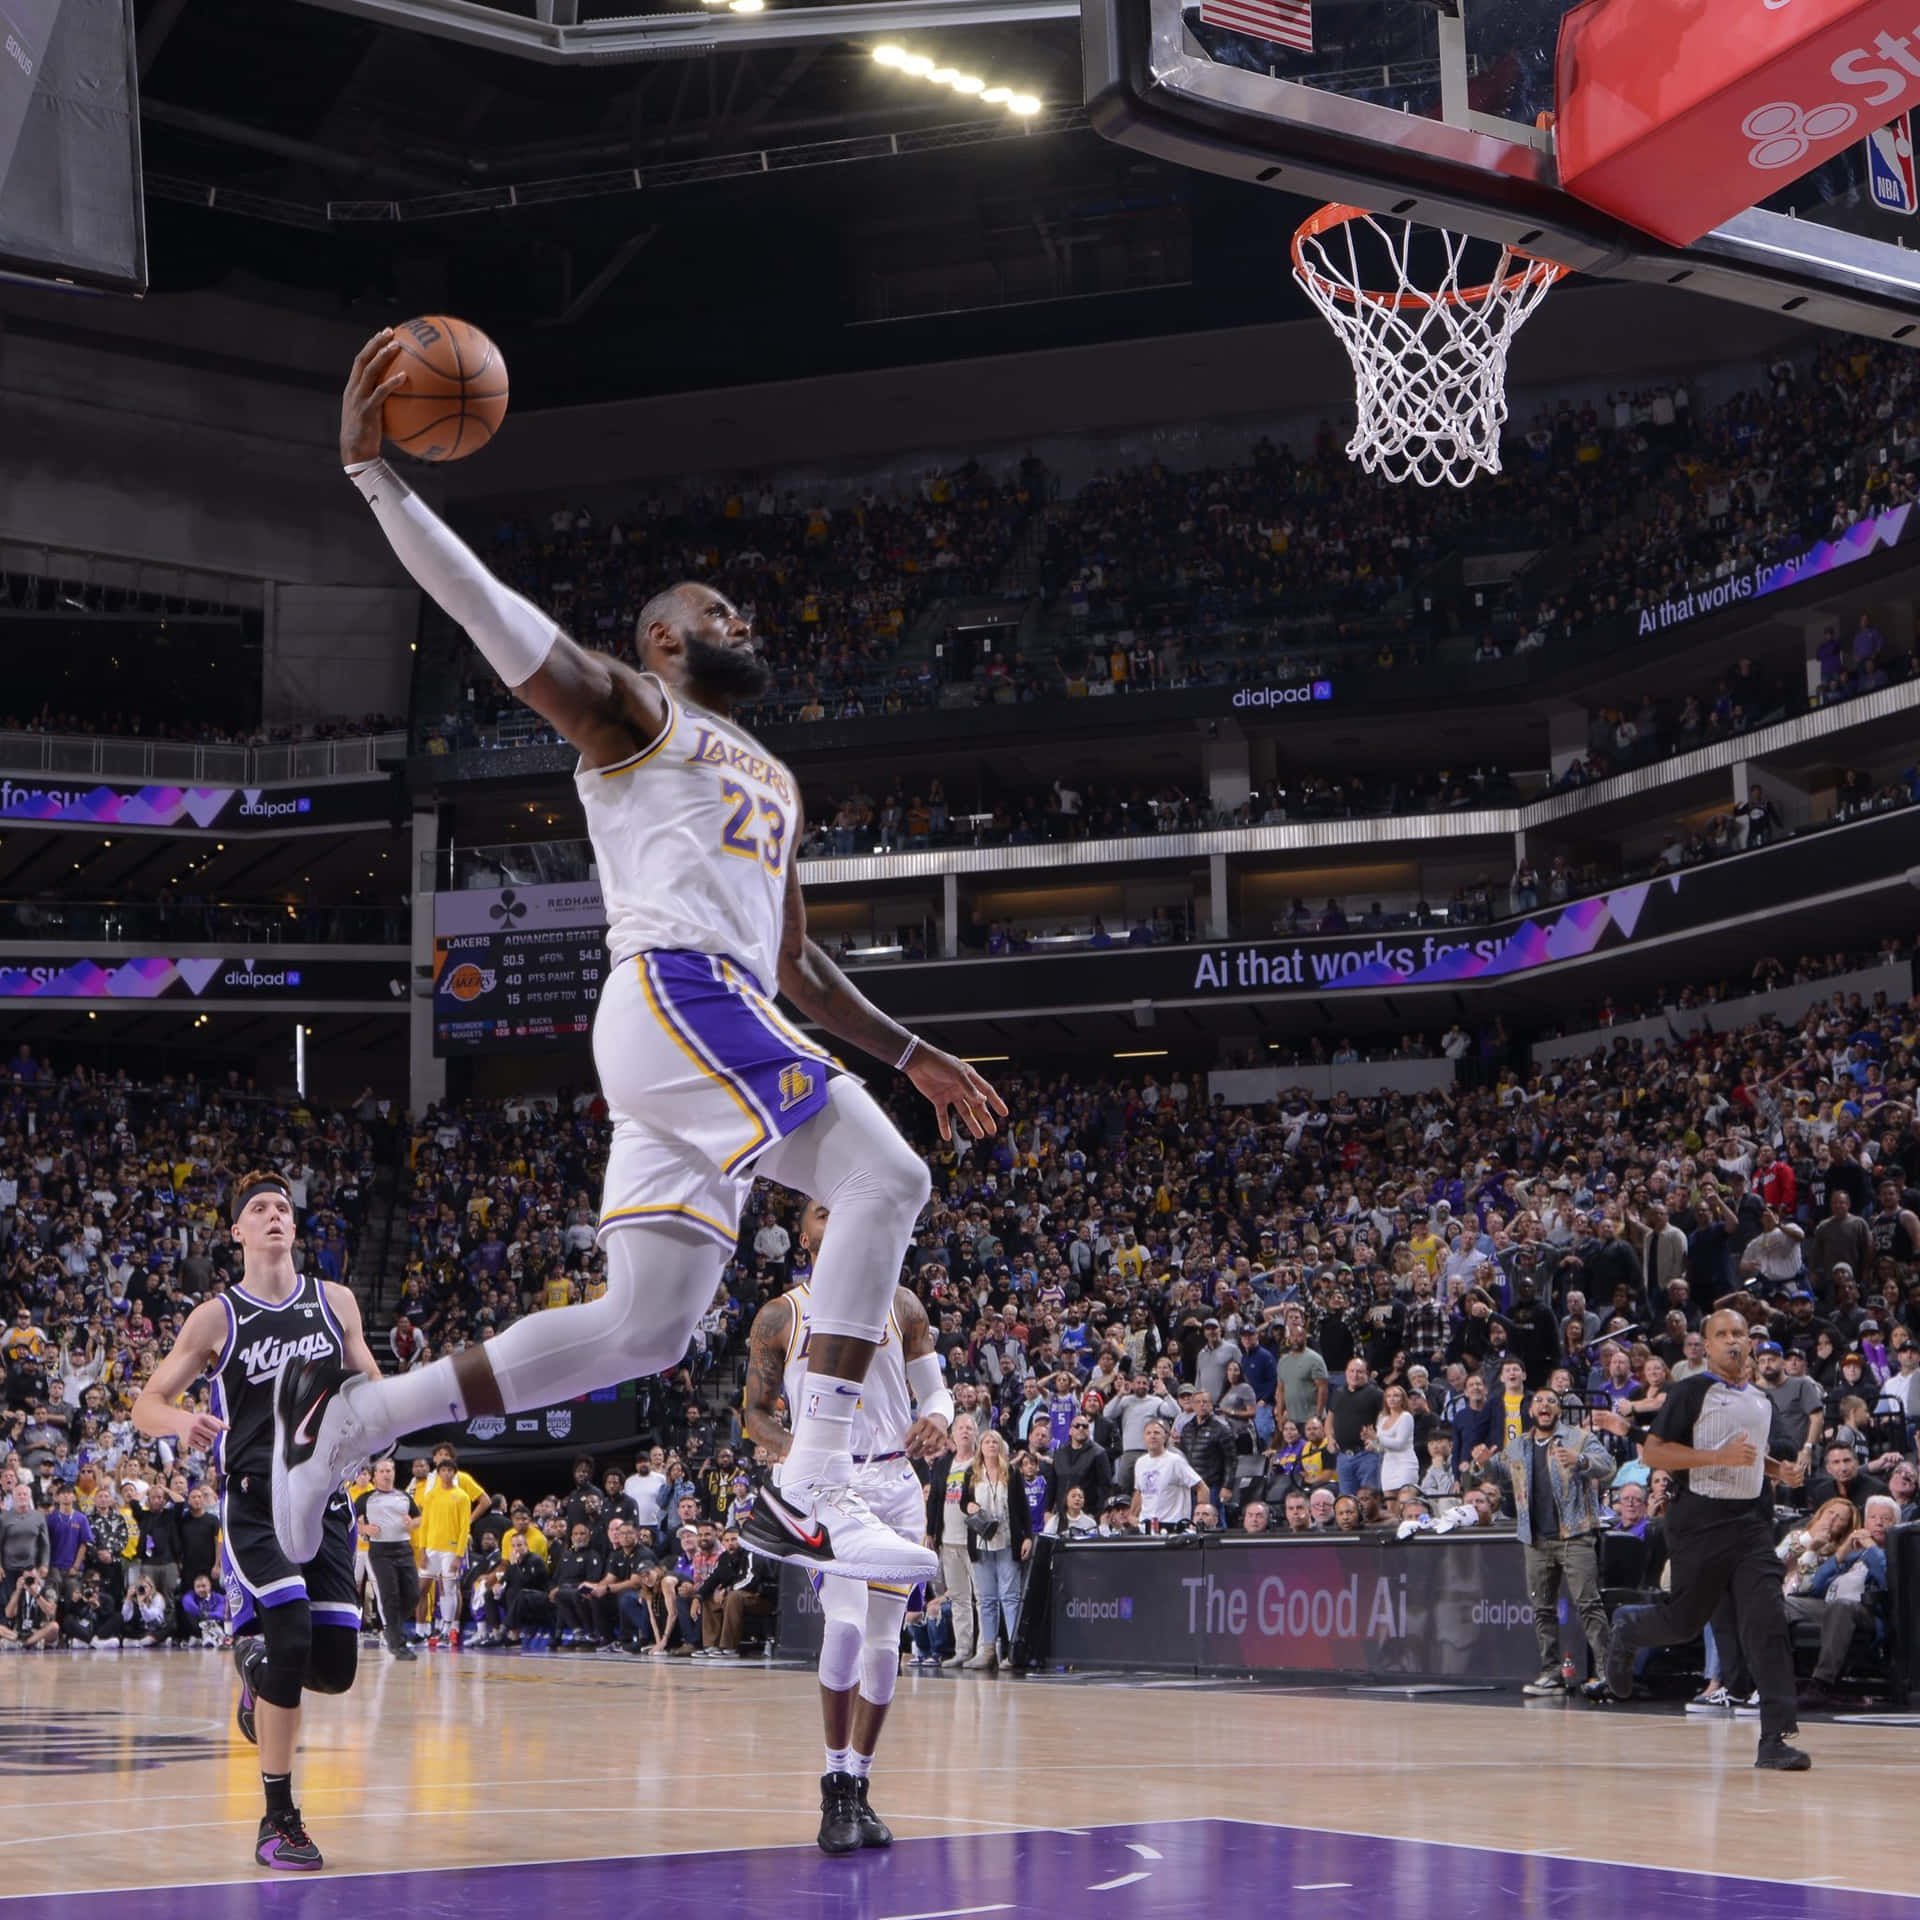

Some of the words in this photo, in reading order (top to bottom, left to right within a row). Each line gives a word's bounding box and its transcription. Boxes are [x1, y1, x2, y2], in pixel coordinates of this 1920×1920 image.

[6, 34, 33, 75] BONUS
[1831, 25, 1920, 106] St
[1876, 175, 1900, 202] NBA
[1638, 608, 1657, 636] Ai
[1659, 594, 1695, 628] that
[1697, 575, 1751, 612] works
[1232, 683, 1311, 708] dialpad
[684, 727, 791, 807] LAKERS
[240, 800, 297, 817] dialpad
[720, 776, 786, 877] 23
[447, 936, 491, 949] LAKERS
[504, 933, 563, 945] ADVANCED
[225, 971, 284, 988] dialpad
[505, 974, 522, 985] 40
[582, 968, 599, 980] 56
[1194, 951, 1228, 989] Ai
[1236, 948, 1305, 986] that
[507, 993, 520, 1005] 15
[584, 988, 597, 999] 10
[239, 1331, 334, 1384] Kings
[1058, 1413, 1066, 1425] 5
[1508, 1424, 1517, 1440] 6
[1029, 1496, 1037, 1507] 5
[1066, 1597, 1119, 1624] dialpad
[1181, 1574, 1249, 1634] The
[1257, 1573, 1359, 1638] Good
[1366, 1573, 1408, 1638] Ai
[1471, 1599, 1536, 1631] dialpa
